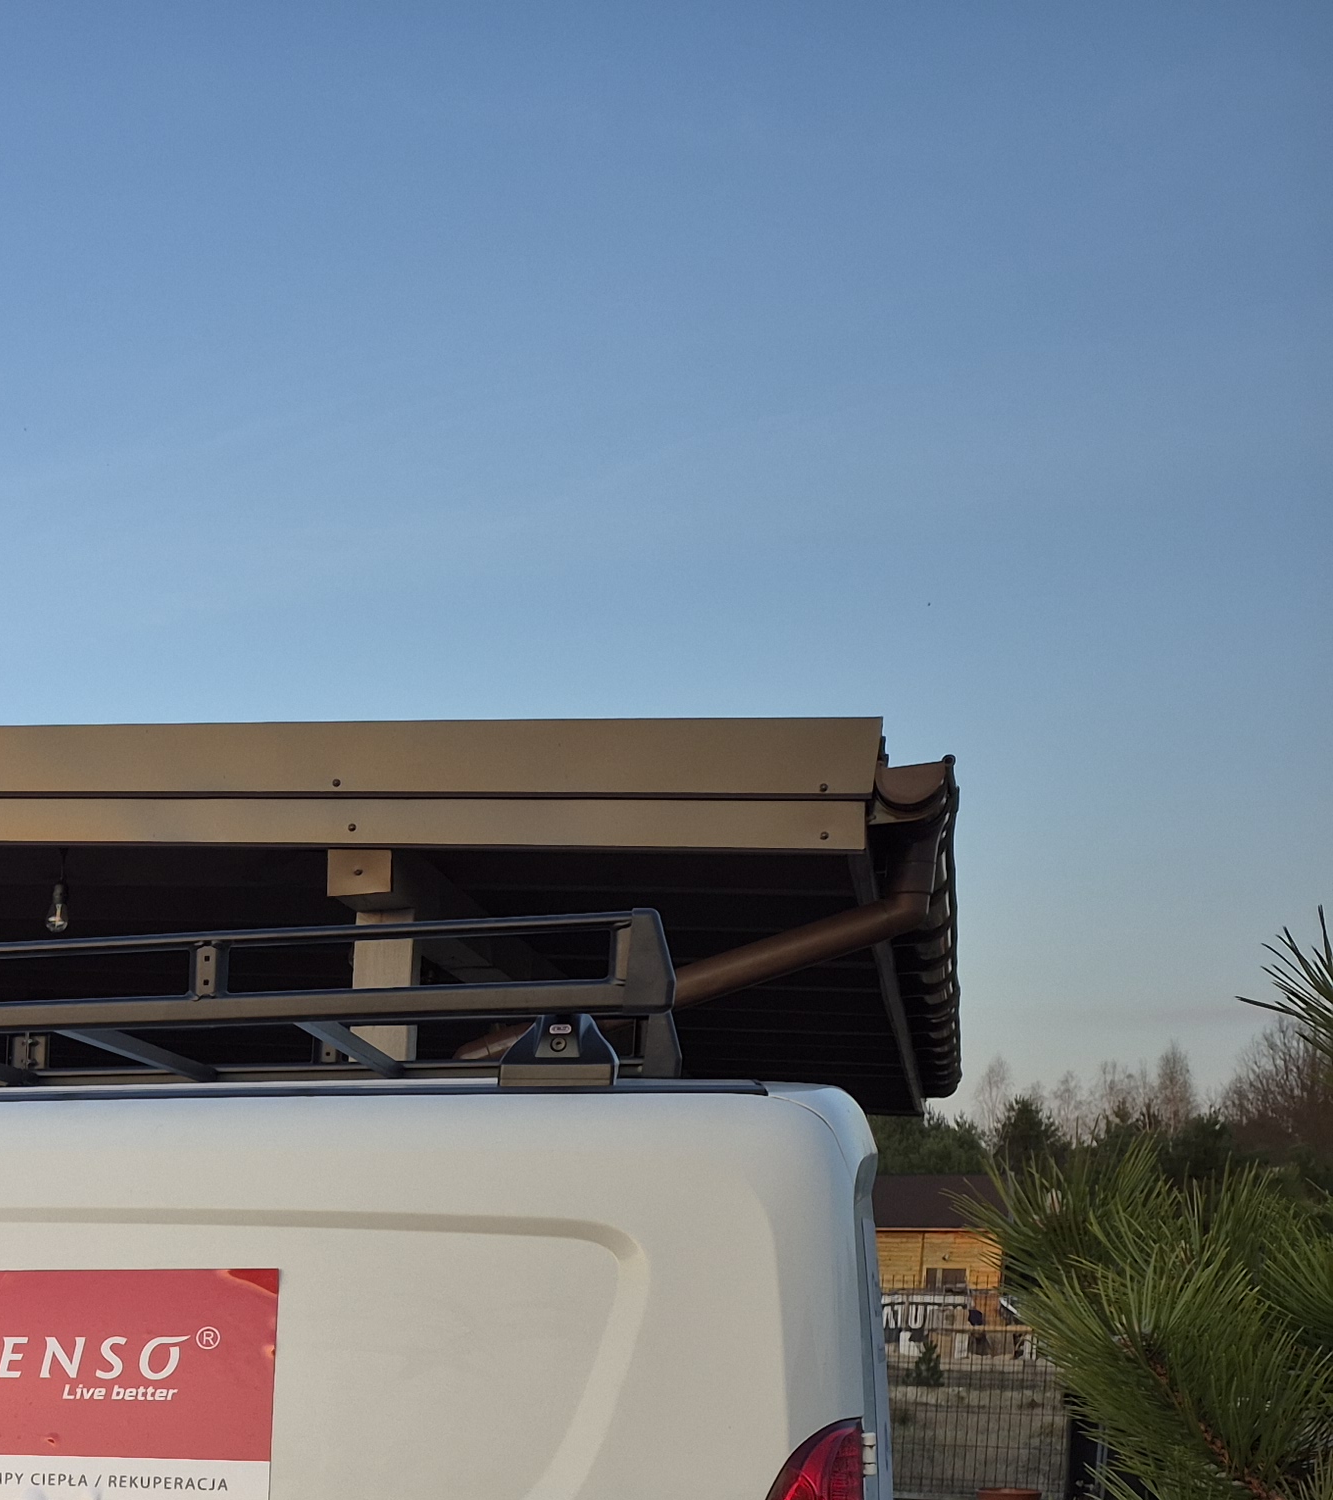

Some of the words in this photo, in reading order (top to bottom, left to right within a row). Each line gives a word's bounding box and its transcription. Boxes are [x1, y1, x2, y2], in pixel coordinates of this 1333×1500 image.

[62, 1384, 106, 1400] Live
[111, 1384, 179, 1401] better
[30, 1472, 88, 1488] CIEPŁA
[94, 1474, 102, 1488] /
[108, 1475, 228, 1492] REKUPERACJA
